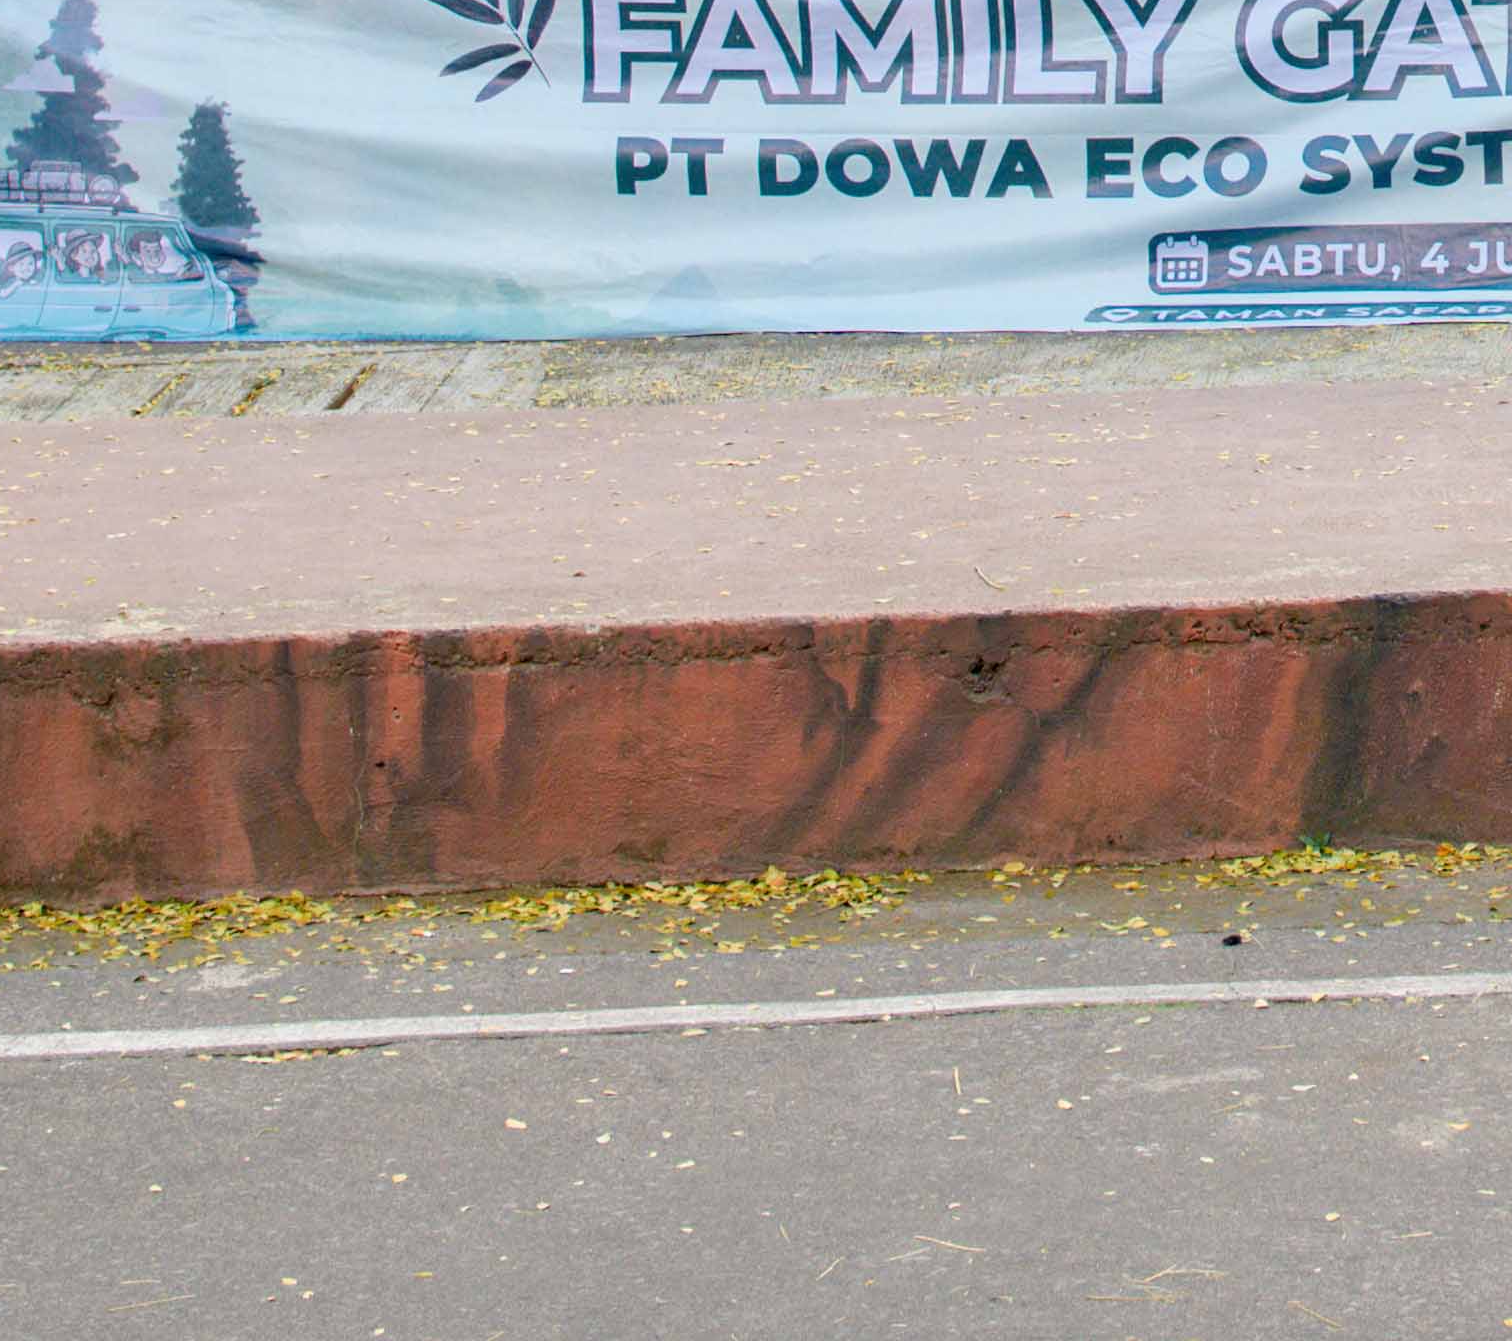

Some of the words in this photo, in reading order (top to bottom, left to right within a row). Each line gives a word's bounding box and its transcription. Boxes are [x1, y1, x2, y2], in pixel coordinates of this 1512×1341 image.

[615, 137, 725, 196] PT
[757, 138, 1053, 199] DOWA
[1086, 136, 1267, 199] ECO
[1227, 242, 1401, 281] SABTU,
[1420, 242, 1449, 274] 4
[1149, 307, 1326, 321] TAMAN
